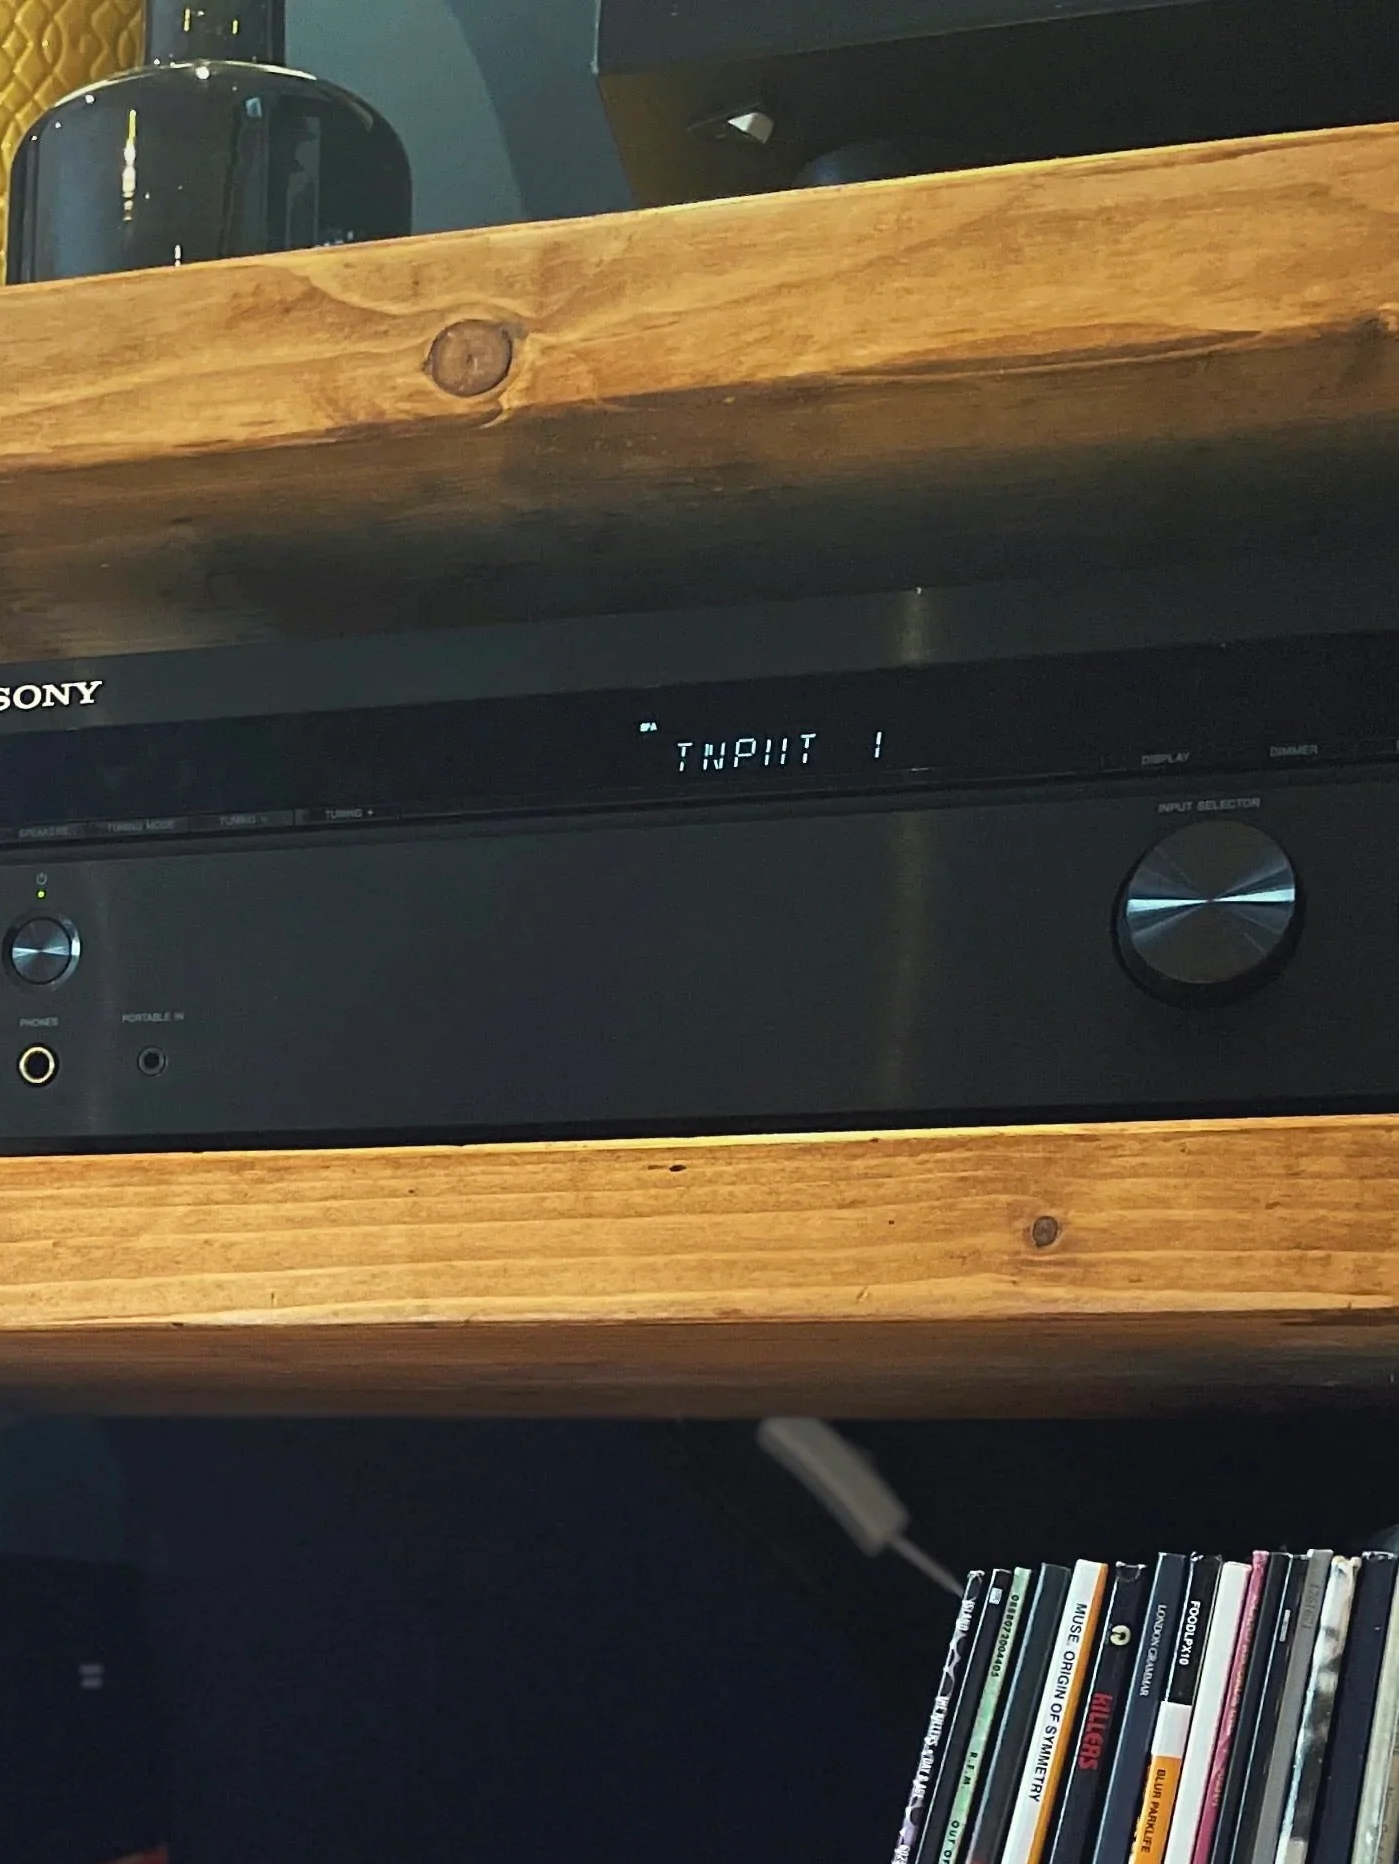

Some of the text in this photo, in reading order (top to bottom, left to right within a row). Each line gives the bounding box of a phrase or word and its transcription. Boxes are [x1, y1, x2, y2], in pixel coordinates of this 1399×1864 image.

[874, 731, 882, 759] 1
[1141, 752, 1190, 765] DISPLAY
[1269, 744, 1319, 757] DIMMER
[1158, 798, 1261, 813] INPUT SELECTOR
[19, 1016, 59, 1028] PHONES
[121, 1011, 185, 1024] PORTABLE IN
[990, 1594, 1020, 1678] 0888072004405
[1178, 1600, 1201, 1666] FOODLPX10
[1140, 1604, 1168, 1697] LONDON GRAMMAR
[1053, 1651, 1077, 1699] ORIGIN
[1049, 1703, 1063, 1722] OF
[1077, 1690, 1113, 1772] KILLERS
[1029, 1725, 1058, 1803] SYMMETRY
[1140, 1768, 1167, 1854] BLUR PARKLIFE
[947, 1819, 961, 1844] OUT
